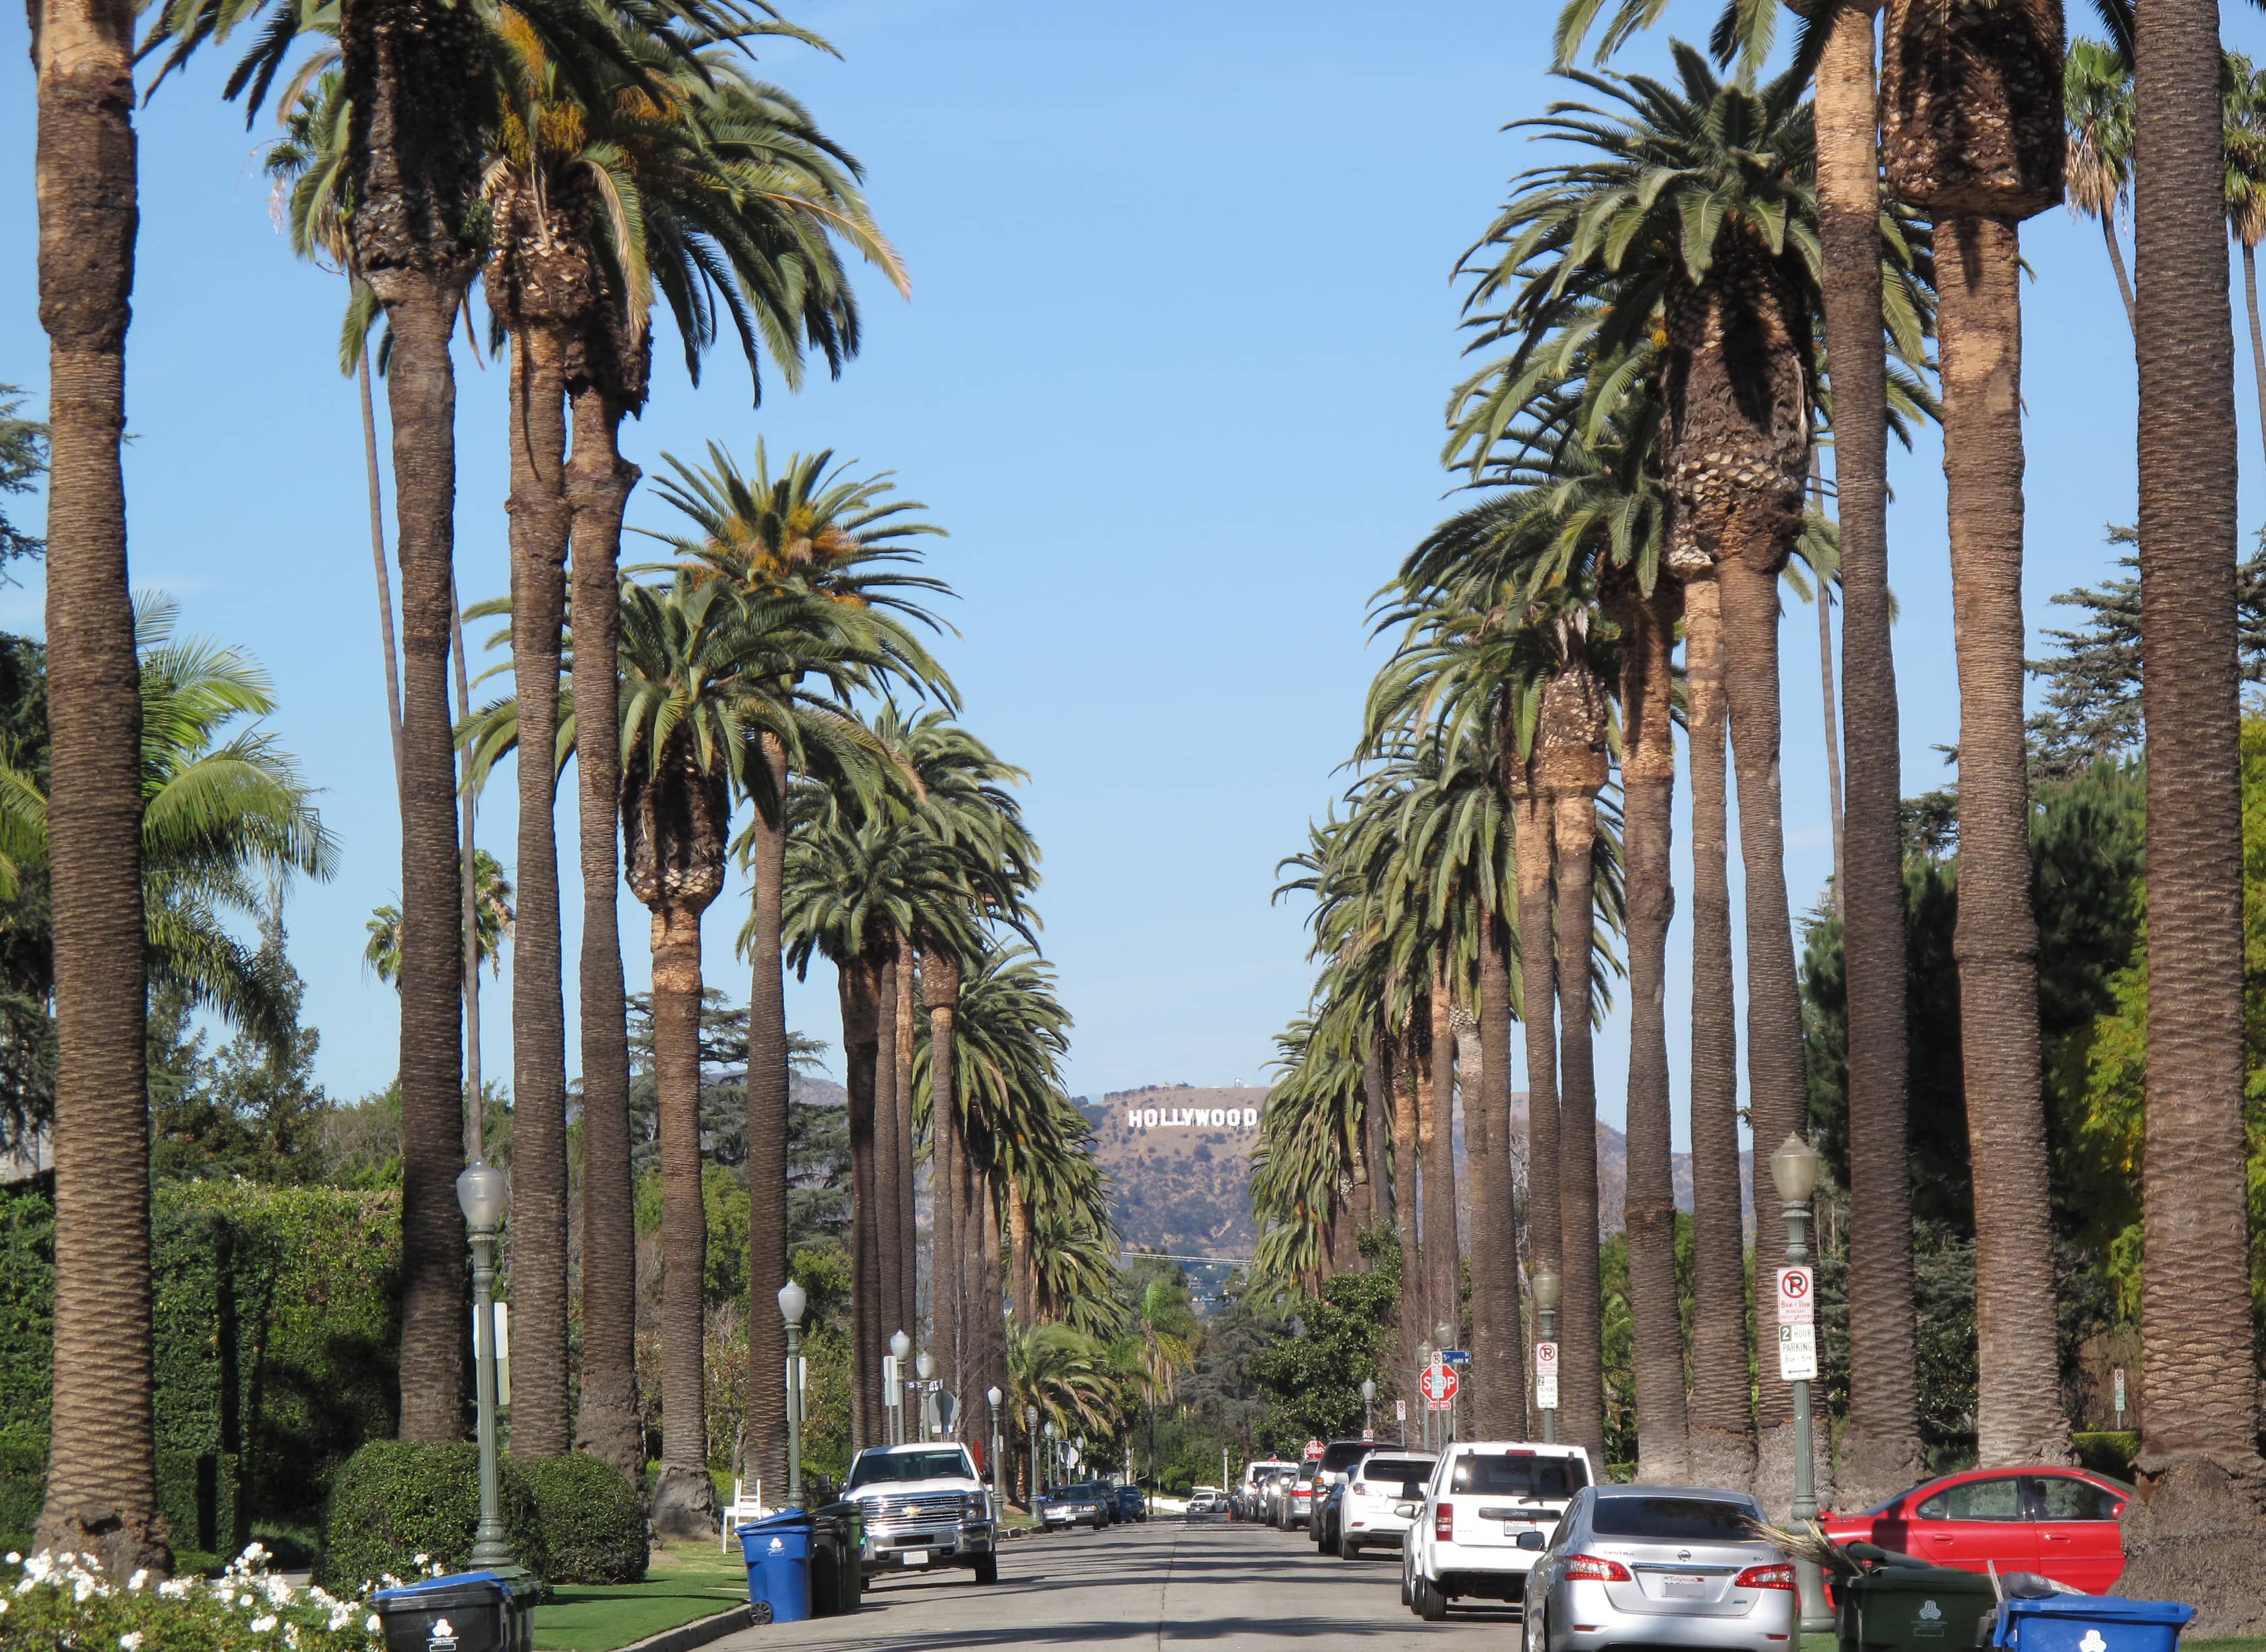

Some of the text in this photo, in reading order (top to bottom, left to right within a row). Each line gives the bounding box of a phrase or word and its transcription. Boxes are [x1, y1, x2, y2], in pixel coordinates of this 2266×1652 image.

[1128, 1107, 1258, 1128] HOLLYWOOD
[1781, 1300, 1793, 1308] 8AM
[1799, 1299, 1811, 1308] 11AM
[1782, 1327, 1812, 1340] 2 HOUR
[1783, 1342, 1813, 1353] PARKING
[1423, 1376, 1456, 1390] SP
